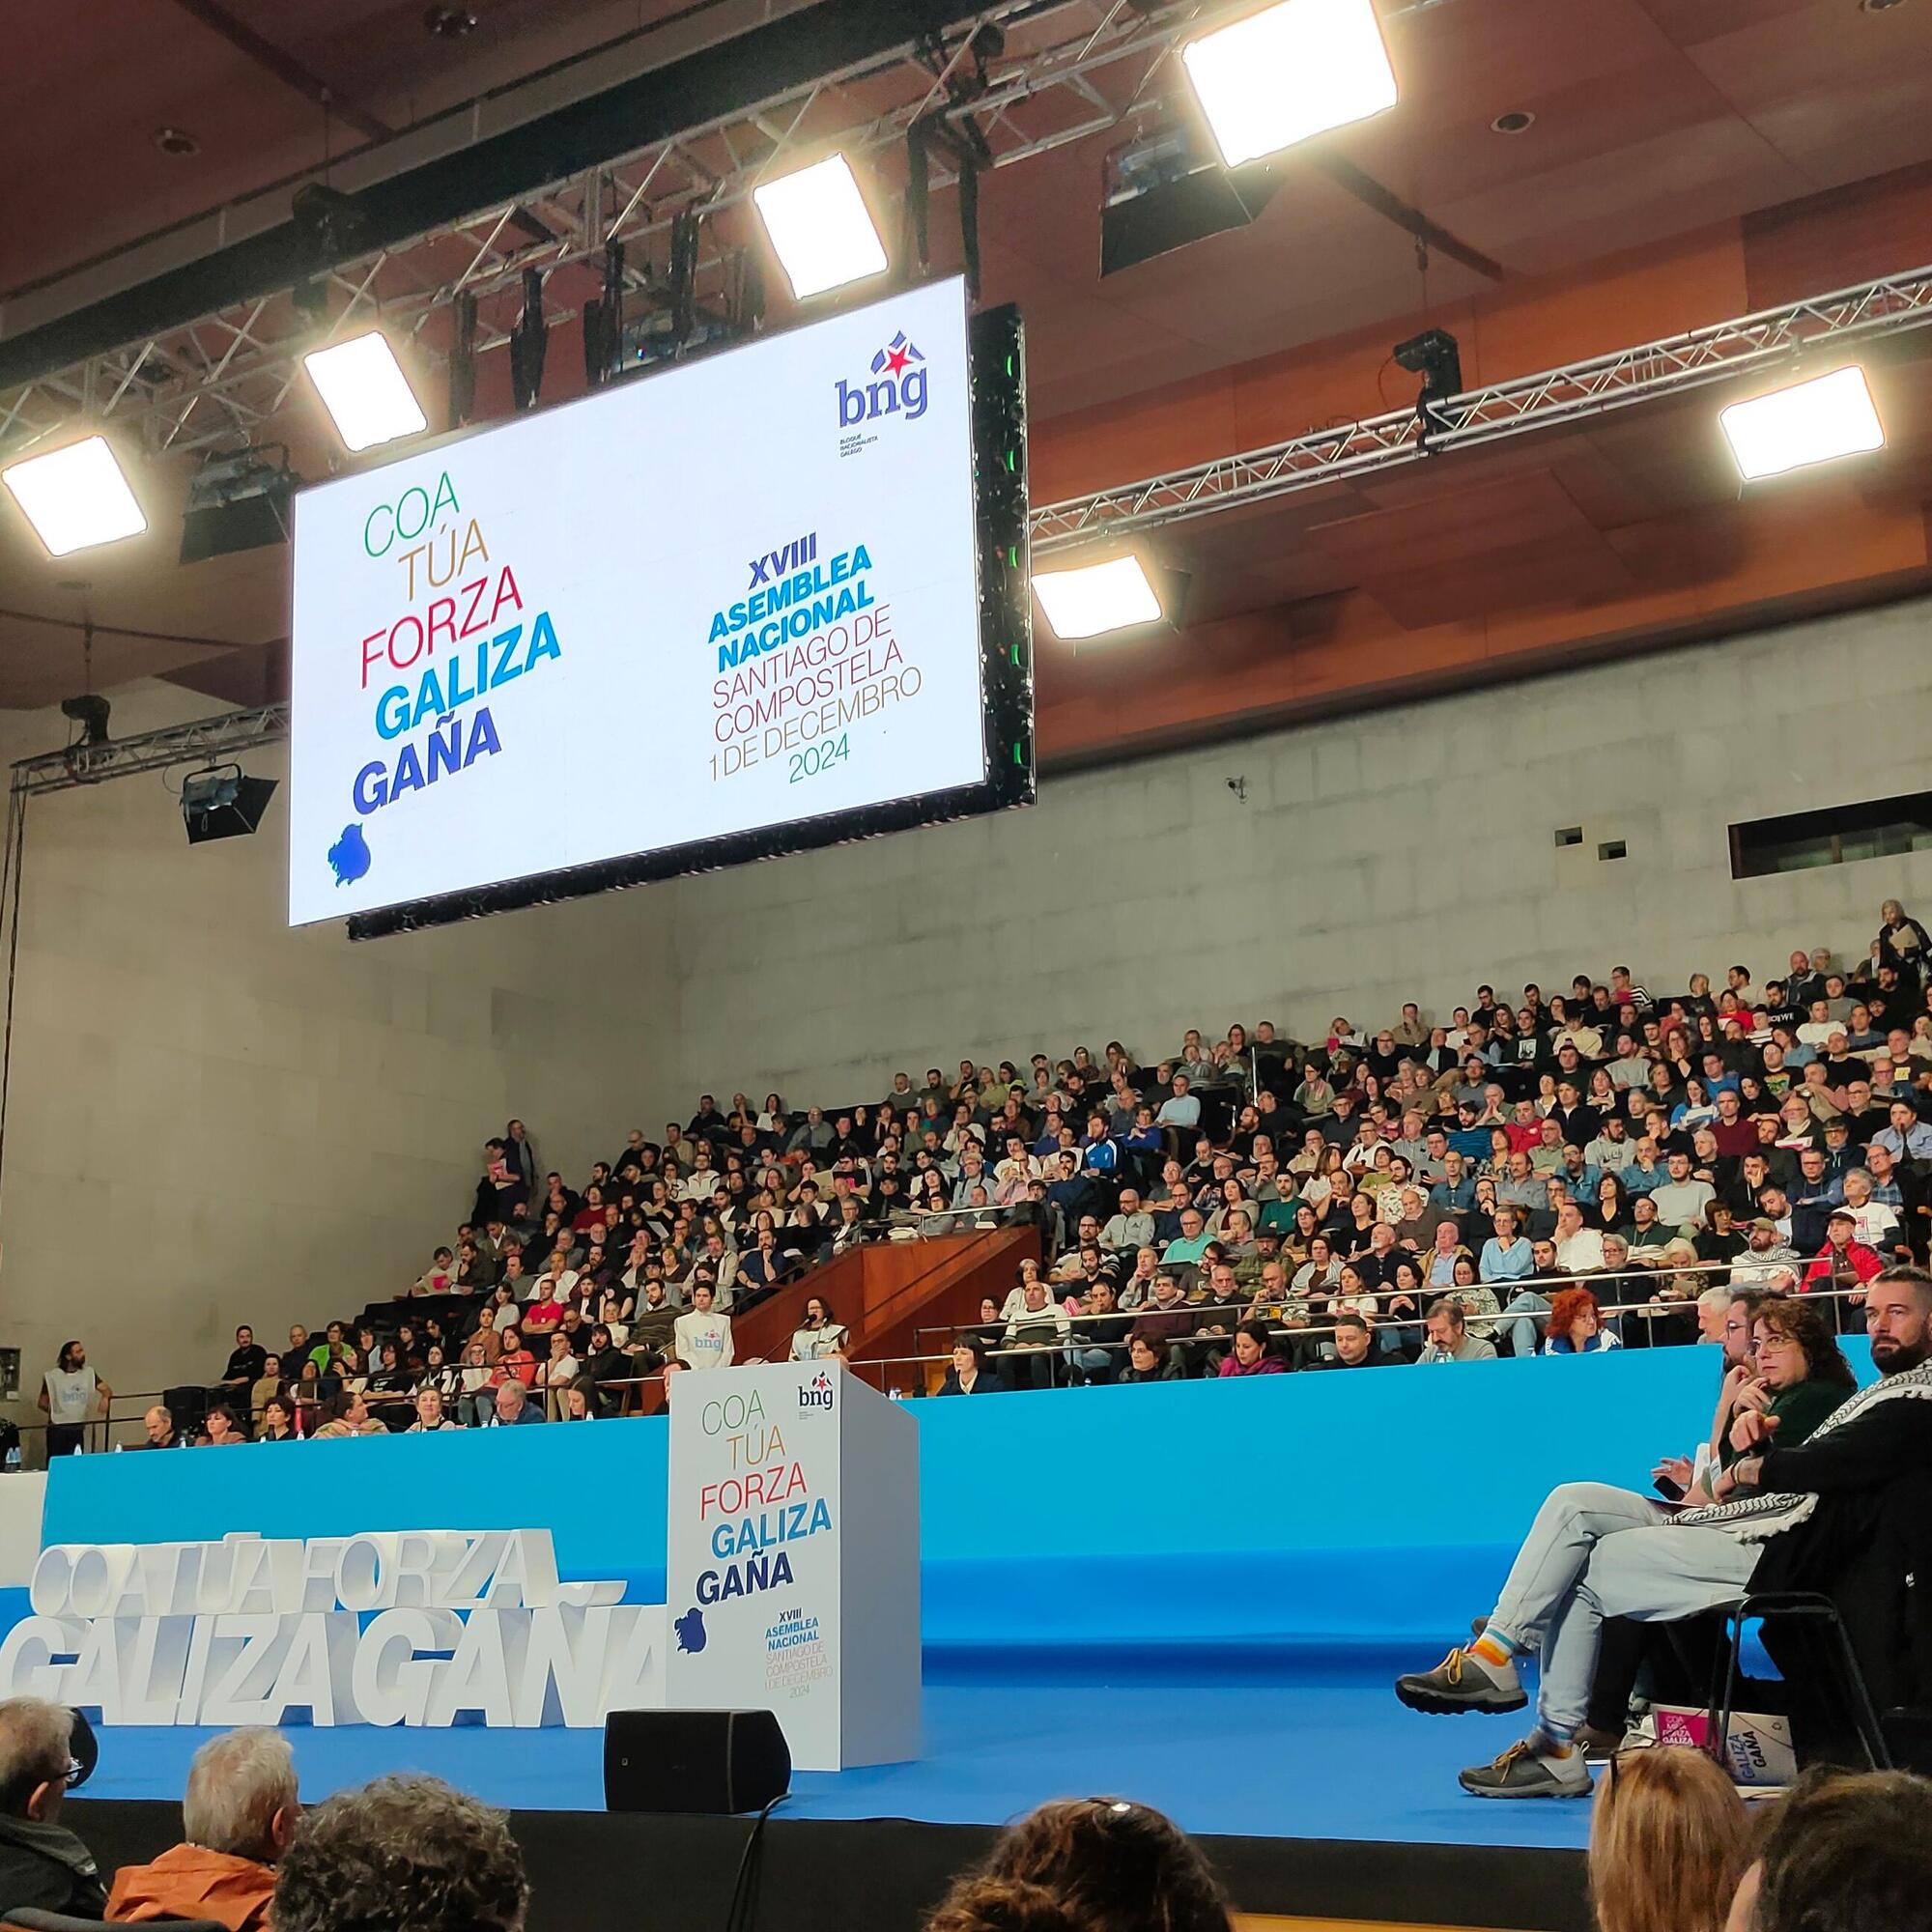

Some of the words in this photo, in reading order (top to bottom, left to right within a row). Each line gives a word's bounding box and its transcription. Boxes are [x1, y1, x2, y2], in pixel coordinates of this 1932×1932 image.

[835, 367, 928, 428] bng
[364, 470, 460, 558] COA
[398, 518, 490, 602] TÚA
[748, 531, 817, 590] XVIII
[707, 544, 873, 644] ASEMBLEA
[361, 565, 524, 690] FORZA
[713, 626, 849, 709] SANTIAGO
[855, 604, 893, 647] DE
[718, 580, 875, 674] NACIONAL
[375, 611, 562, 741] GALIZA
[715, 639, 903, 742] COMPOSTELA
[709, 753, 718, 781] 1
[724, 734, 759, 777] DE
[764, 667, 923, 759] DECEMBRO
[353, 707, 502, 815] GAÑA
[789, 732, 851, 784] 2024
[695, 1336, 722, 1351] bng
[702, 1389, 765, 1435] COA
[797, 1385, 835, 1410] bng
[726, 1423, 785, 1471] TÚA
[701, 1462, 808, 1521] FORZA
[711, 1497, 833, 1559] GALIZA
[30, 1543, 152, 1617] COA
[300, 1528, 541, 1611] FORZA
[696, 1548, 794, 1605] GAÑA
[765, 1616, 819, 1639] ASEMBLEA
[768, 1630, 820, 1652] NACIONAL
[779, 1607, 802, 1624] XVIII
[0, 1613, 338, 1727] GALIZA
